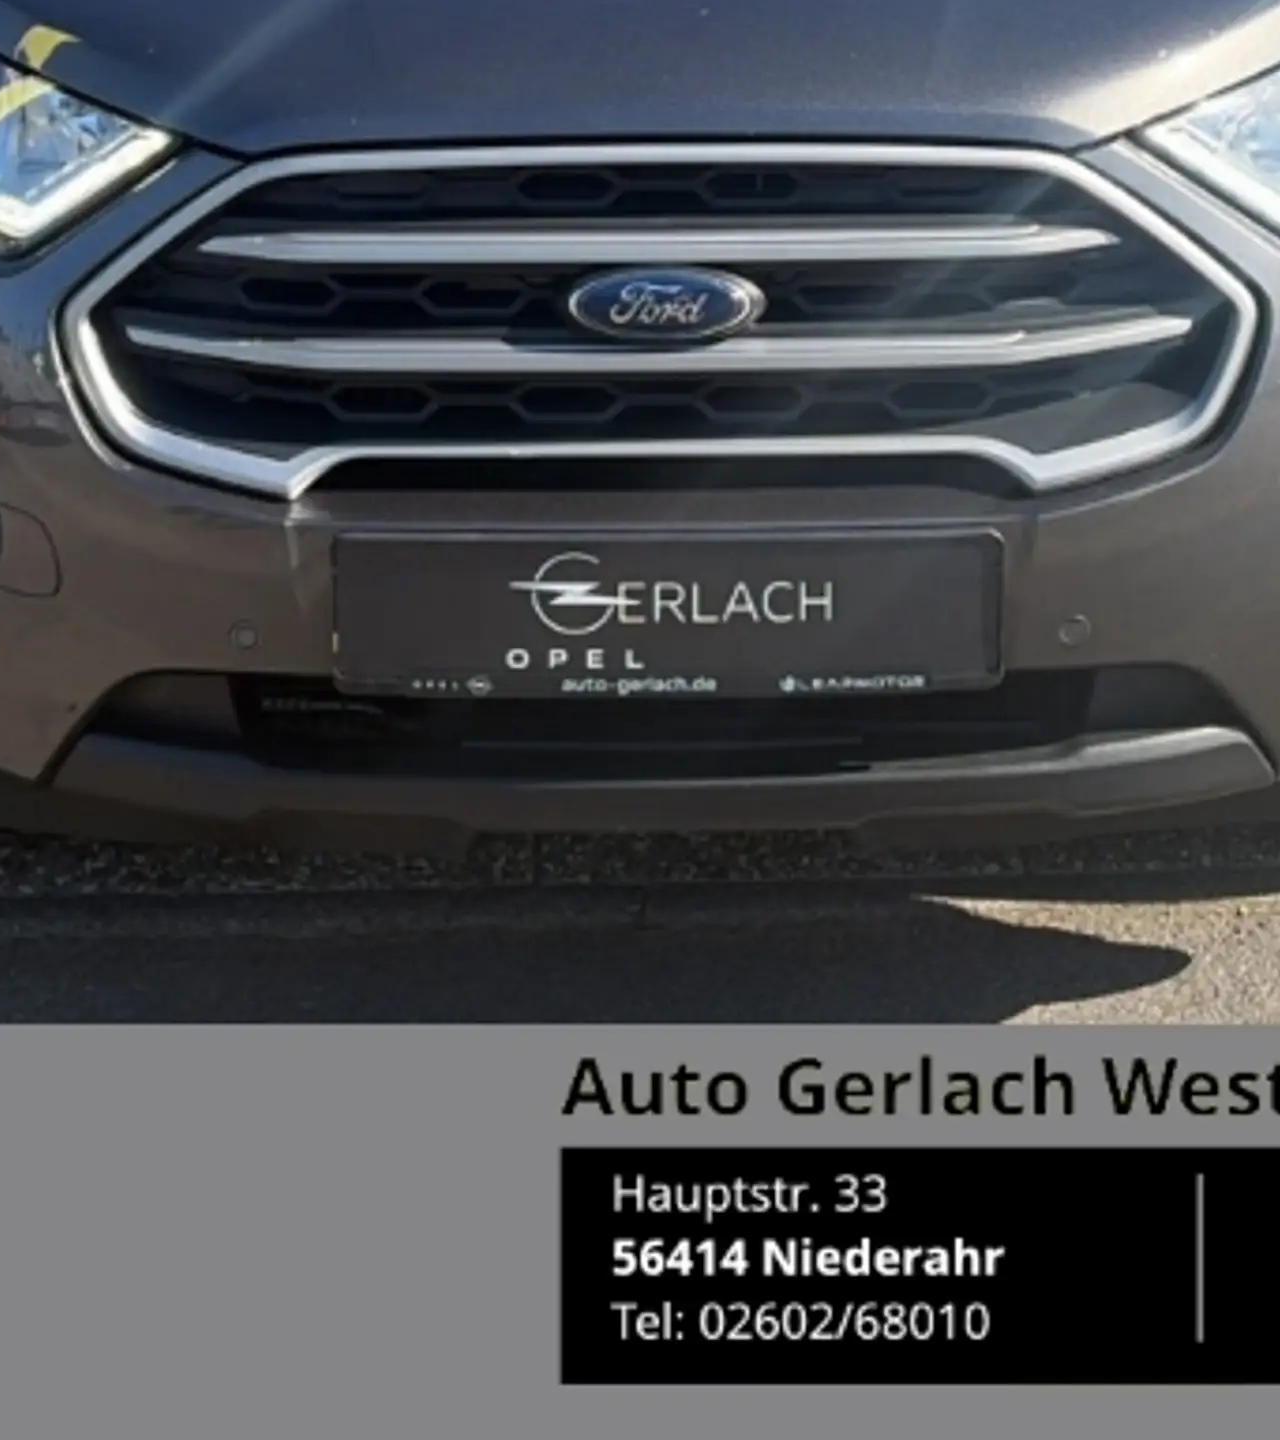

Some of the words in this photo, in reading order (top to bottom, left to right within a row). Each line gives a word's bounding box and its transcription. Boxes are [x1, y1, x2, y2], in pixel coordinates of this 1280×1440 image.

[609, 282, 708, 324] Ford
[505, 648, 645, 670] OPEL
[560, 674, 718, 695] auto-gerlach.de
